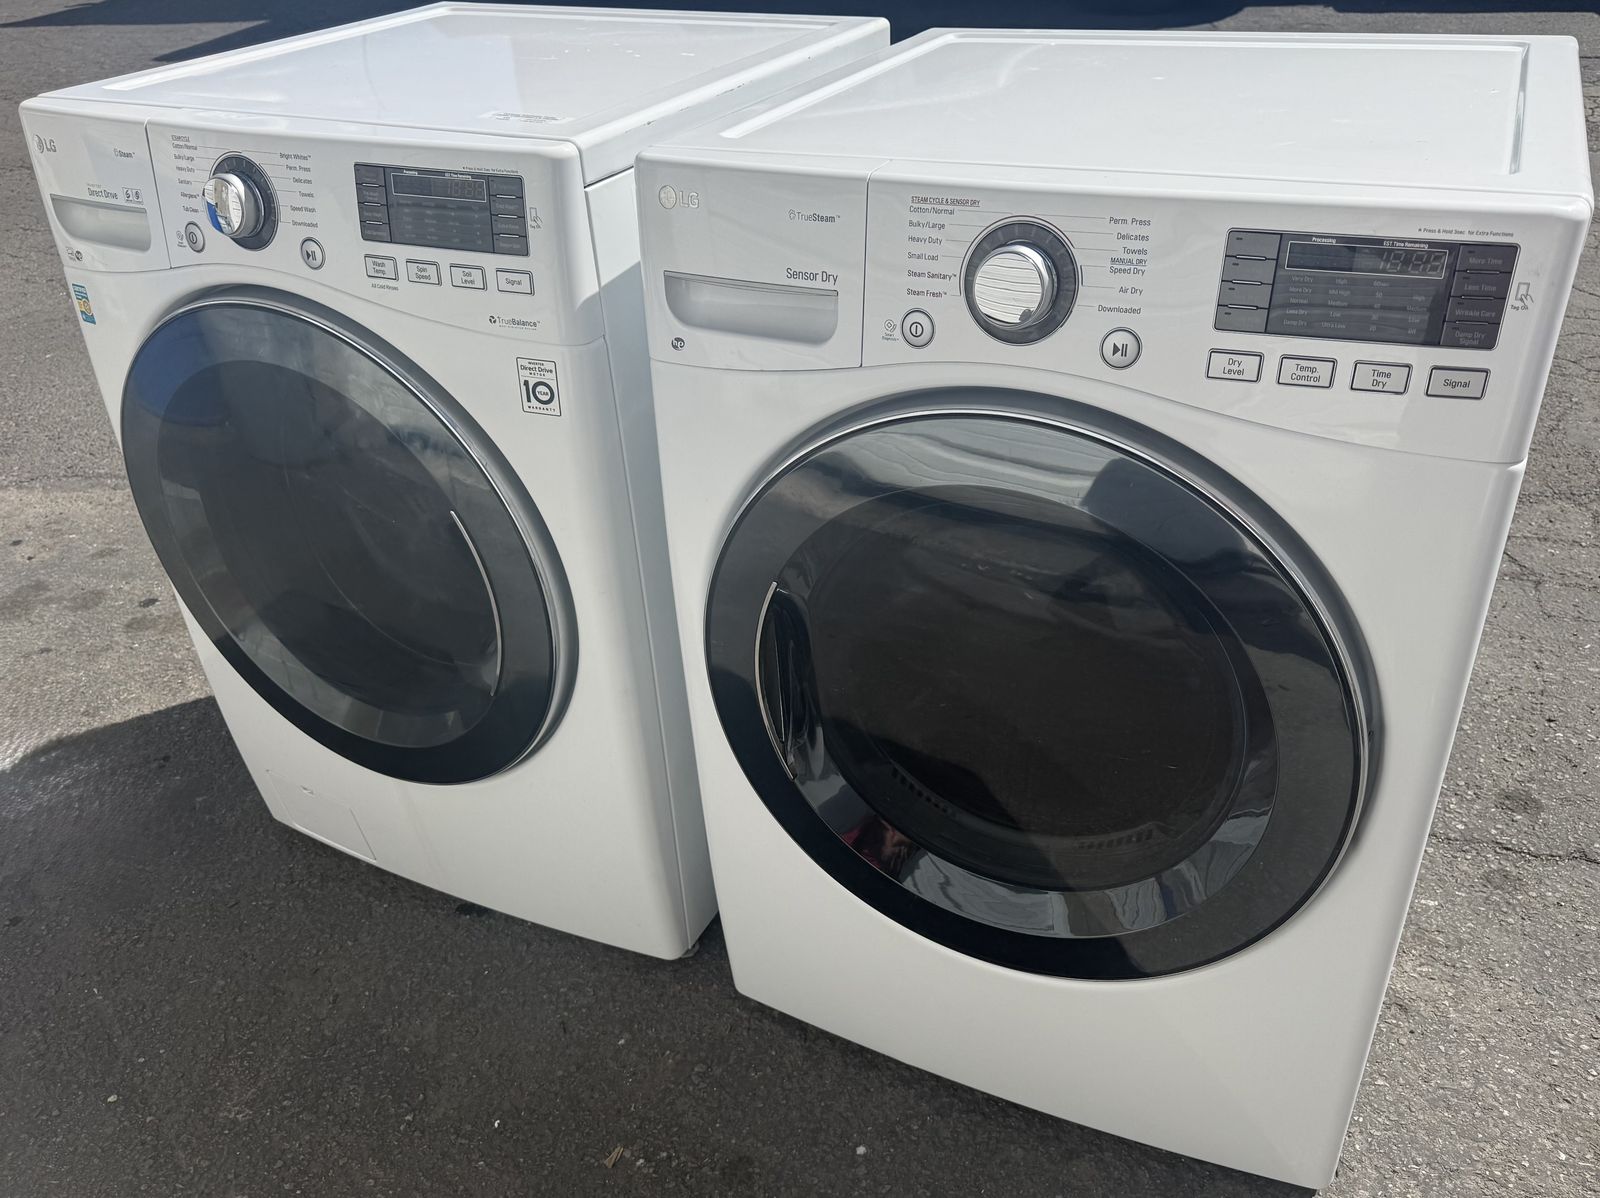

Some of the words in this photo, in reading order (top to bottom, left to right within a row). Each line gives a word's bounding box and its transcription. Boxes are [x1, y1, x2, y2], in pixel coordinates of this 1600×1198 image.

[43, 138, 57, 153] LG
[87, 187, 104, 198] Direct
[103, 189, 118, 200] Drive
[679, 191, 699, 208] LG
[911, 196, 929, 204] STEAM
[929, 197, 945, 205] CYCLE
[949, 198, 969, 206] SENSOR
[909, 205, 955, 215] Cotton/Normal
[908, 220, 946, 230] Bulky/Large
[1131, 217, 1151, 226] Press
[908, 235, 927, 245] Heavy
[928, 236, 943, 245] Duty
[1116, 232, 1150, 242] Delicates
[1122, 246, 1148, 255] Towels
[907, 251, 924, 260] Small
[924, 253, 938, 261] Load
[371, 260, 386, 268] Wash
[1110, 257, 1135, 265] MANUAL
[1135, 258, 1148, 266] DRY
[416, 266, 428, 274] Spin
[462, 270, 473, 278] Soil
[907, 270, 926, 278] Steam
[1109, 266, 1131, 275] Speed
[1132, 267, 1145, 276] Dry
[415, 273, 431, 281] Speed
[461, 277, 475, 285] Level
[786, 267, 819, 281] Sensor
[821, 271, 838, 286] Dry
[505, 278, 522, 287] Signal
[906, 288, 925, 297] Steam
[1119, 286, 1129, 294] Air
[1130, 287, 1143, 296] Dry
[1097, 304, 1142, 315] Downloaded
[1227, 357, 1243, 368] Dry
[520, 365, 538, 373] Direct
[1222, 367, 1244, 376] Level
[1295, 363, 1319, 374] Temp.
[1290, 372, 1320, 383] Control
[1371, 369, 1392, 379] Time
[1371, 378, 1387, 389] Dry
[1443, 378, 1471, 389] Signal
[523, 379, 555, 405] 10
